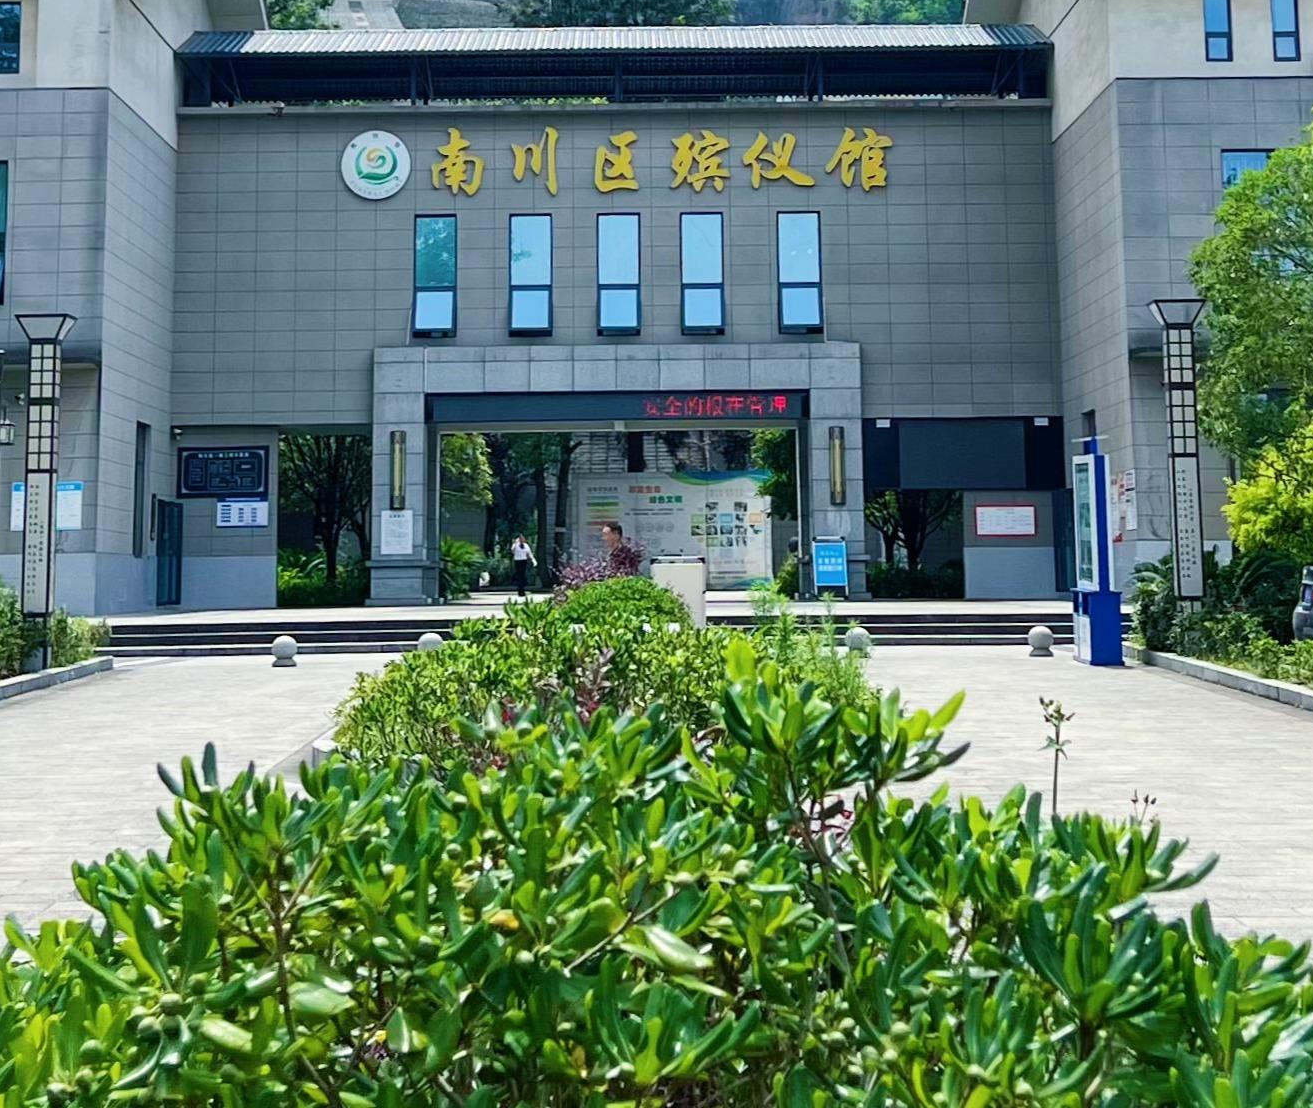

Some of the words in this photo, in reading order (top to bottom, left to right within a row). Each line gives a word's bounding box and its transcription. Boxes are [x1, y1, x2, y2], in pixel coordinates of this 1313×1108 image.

[431, 126, 893, 196] 南川区殡仪馆
